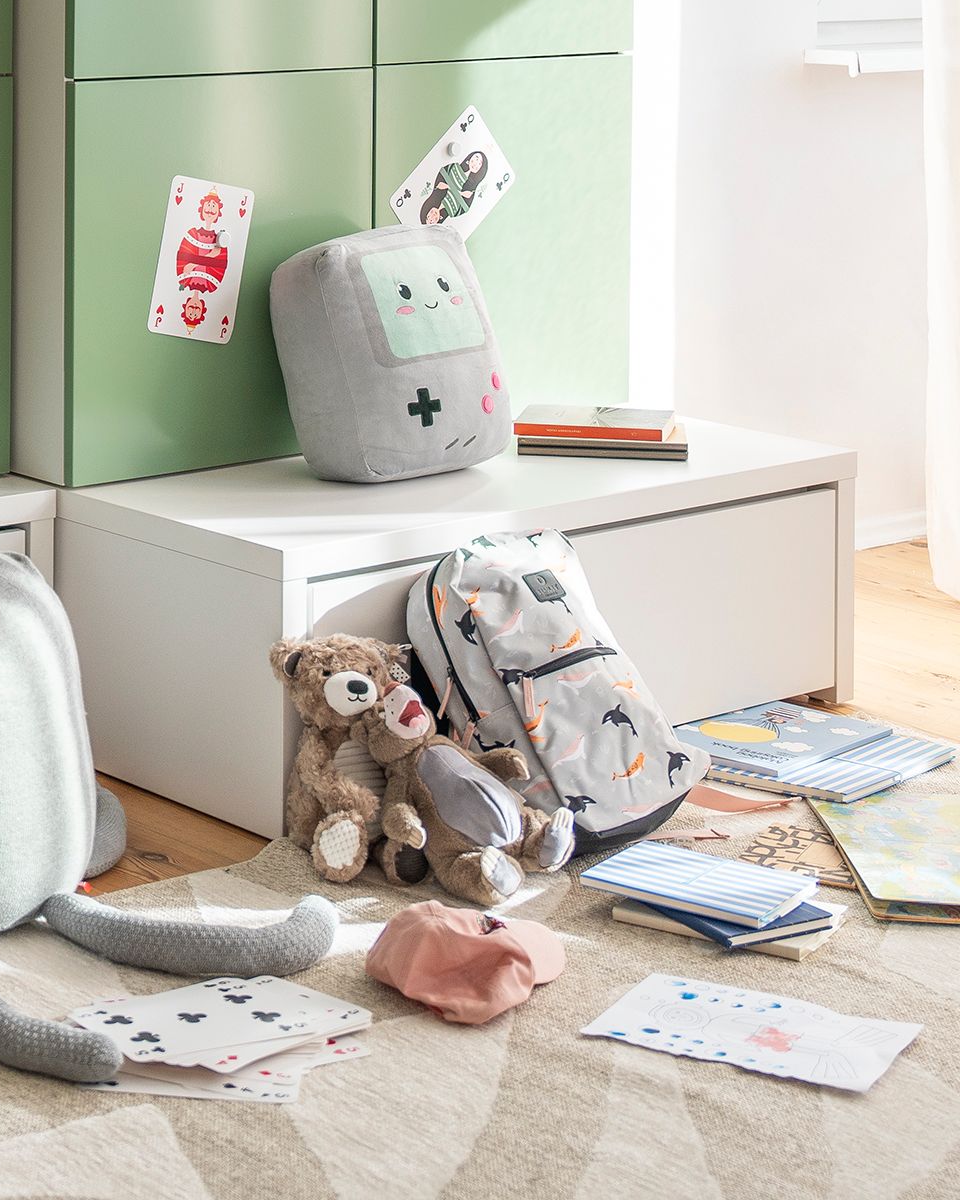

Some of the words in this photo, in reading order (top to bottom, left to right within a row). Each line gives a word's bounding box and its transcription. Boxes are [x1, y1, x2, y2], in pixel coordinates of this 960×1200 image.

[177, 182, 184, 194] J
[240, 195, 248, 206] J
[155, 316, 163, 328] J
[220, 327, 227, 339] J
